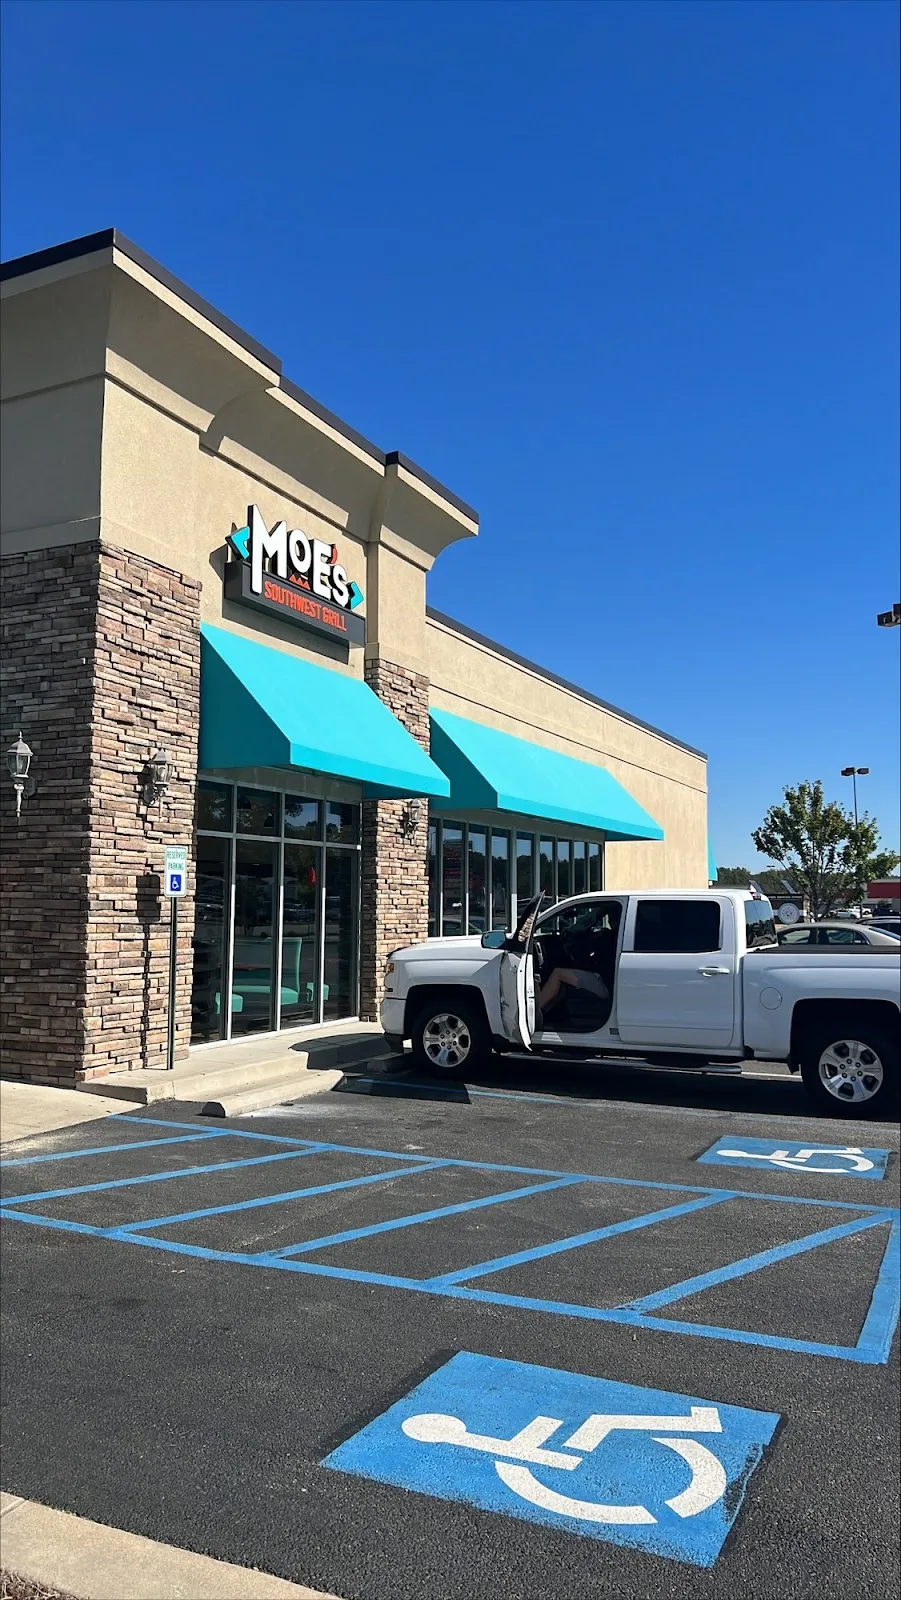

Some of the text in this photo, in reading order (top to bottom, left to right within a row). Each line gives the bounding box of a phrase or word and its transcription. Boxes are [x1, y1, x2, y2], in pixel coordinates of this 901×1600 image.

[249, 504, 349, 608] MOE'S
[264, 580, 347, 632] SOUTHWEST GRILL
[166, 850, 186, 860] RESERVED
[167, 862, 184, 871] PARKING
